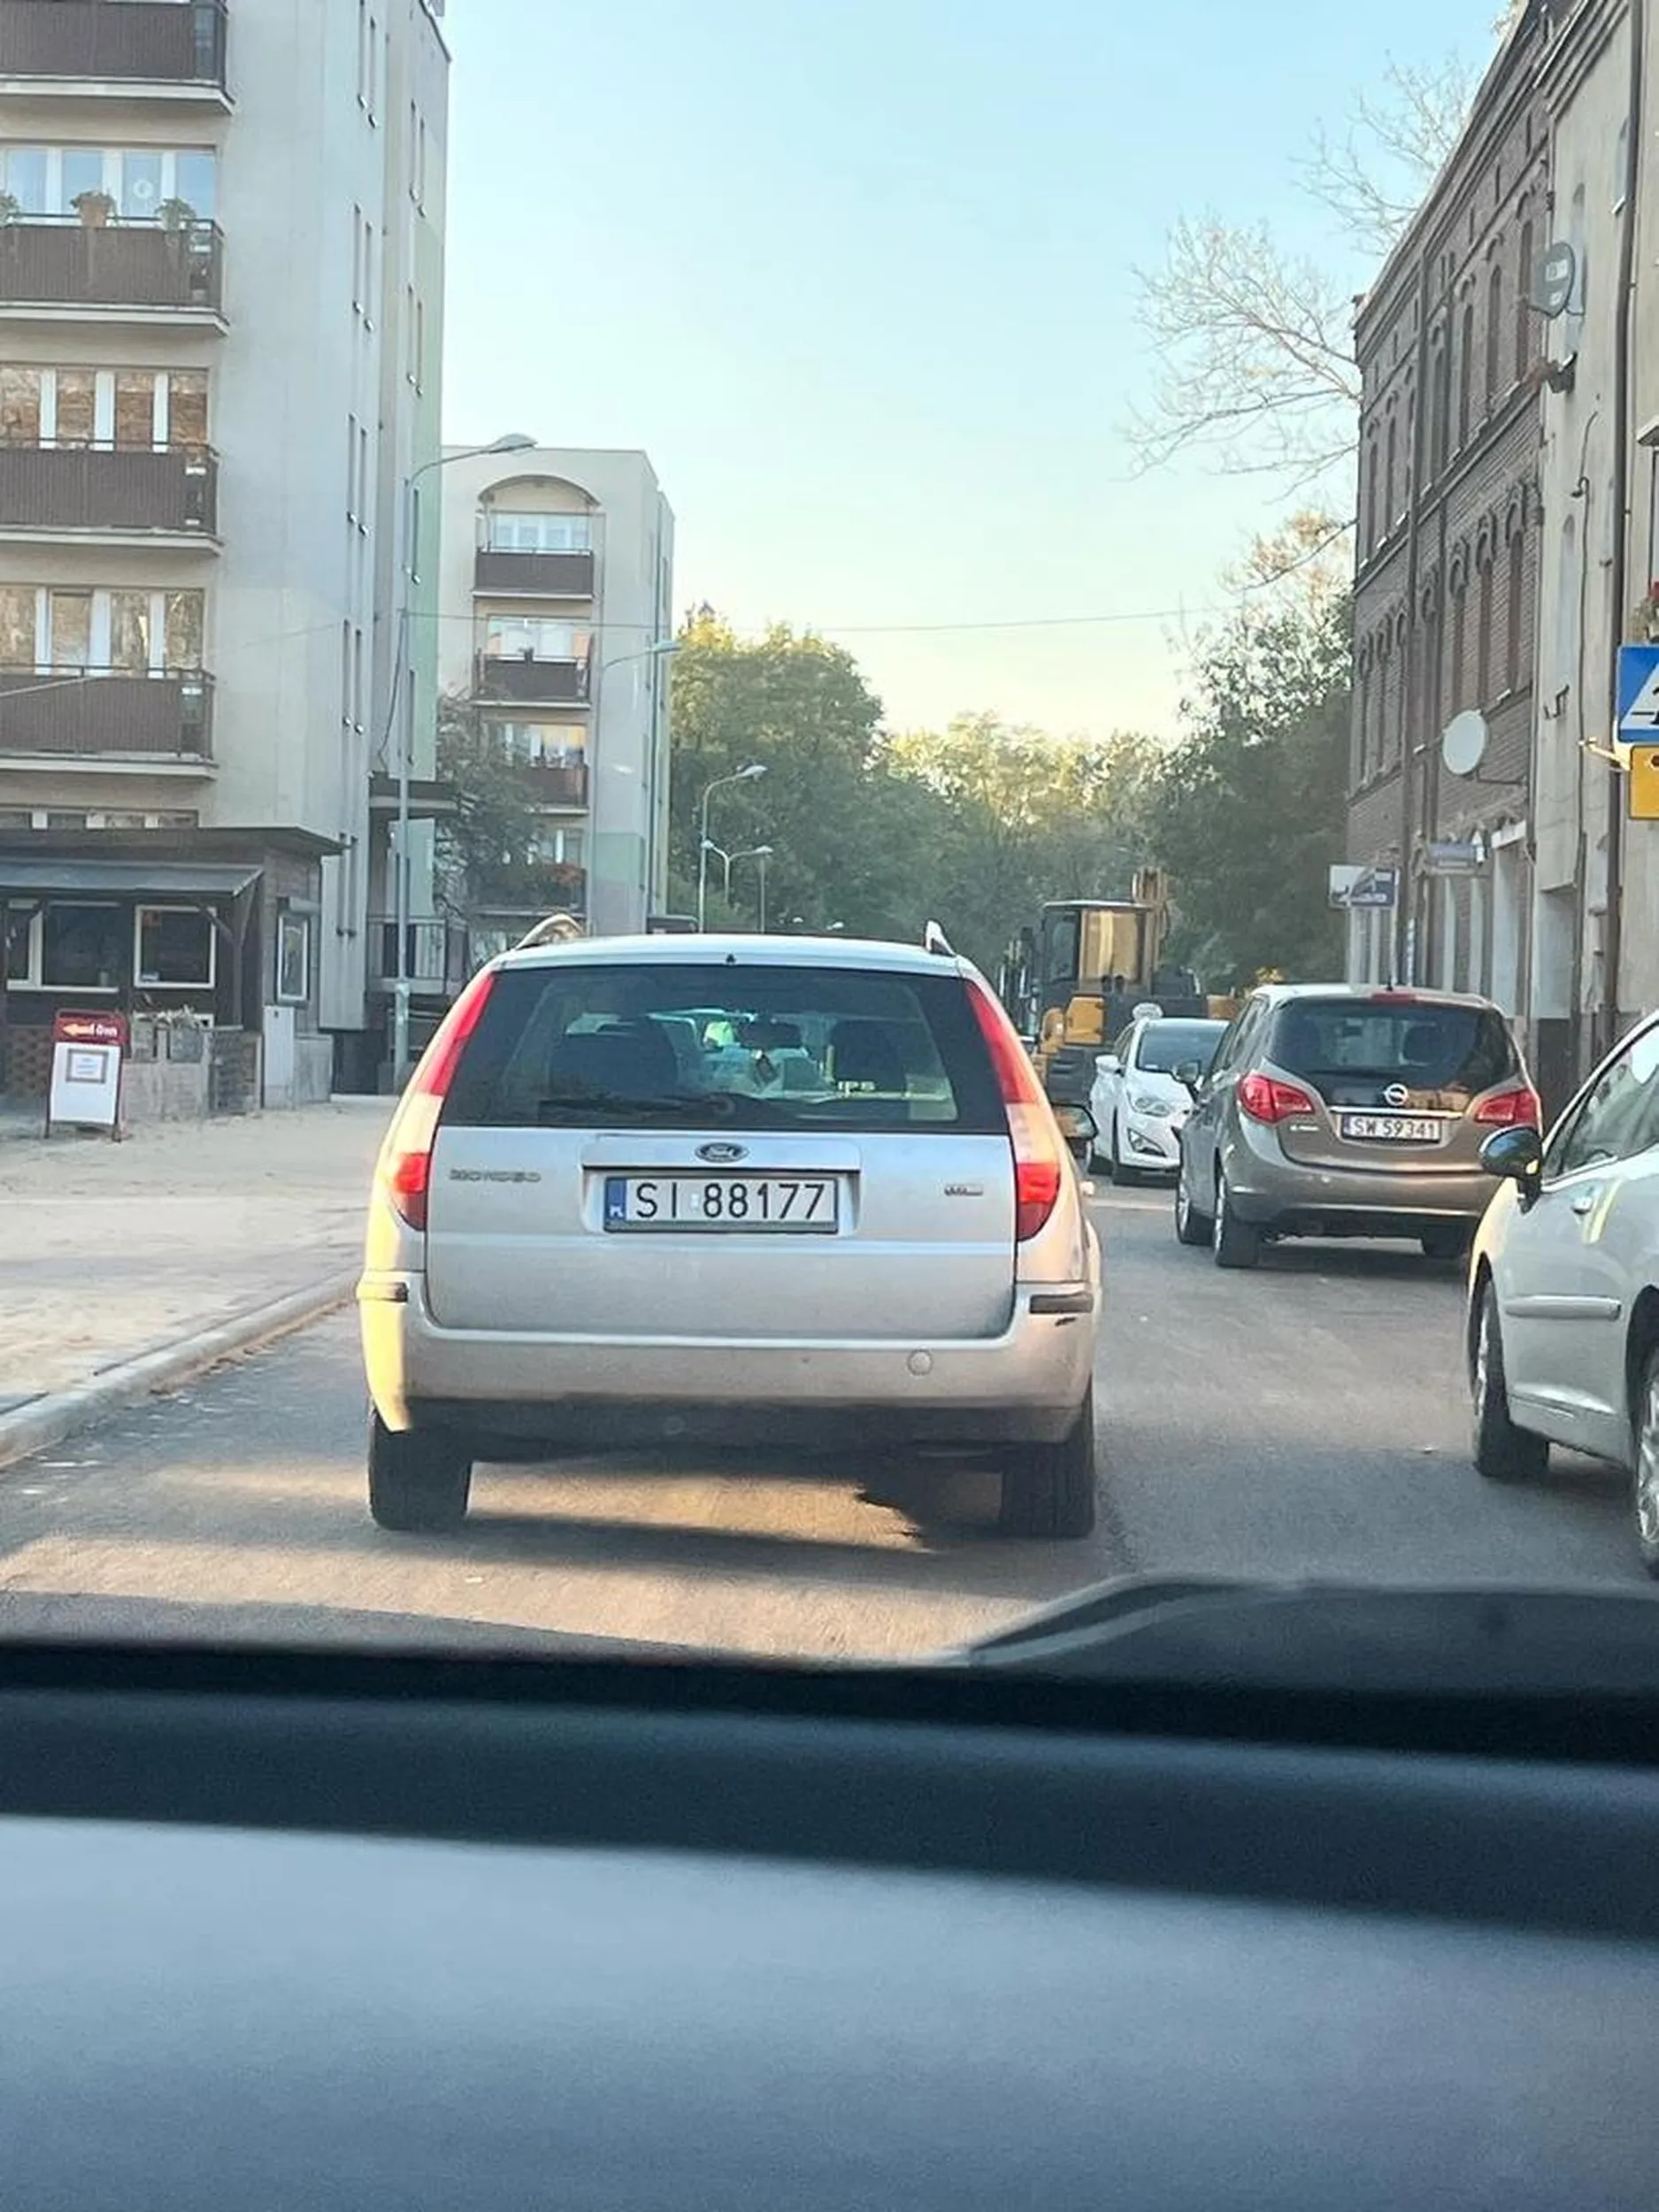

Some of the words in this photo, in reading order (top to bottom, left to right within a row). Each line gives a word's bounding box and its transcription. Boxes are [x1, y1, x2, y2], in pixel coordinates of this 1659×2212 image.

[1355, 1118, 1376, 1134] SW
[1384, 1119, 1433, 1137] 59341
[636, 1182, 677, 1218] SI
[703, 1183, 825, 1219] 88177
